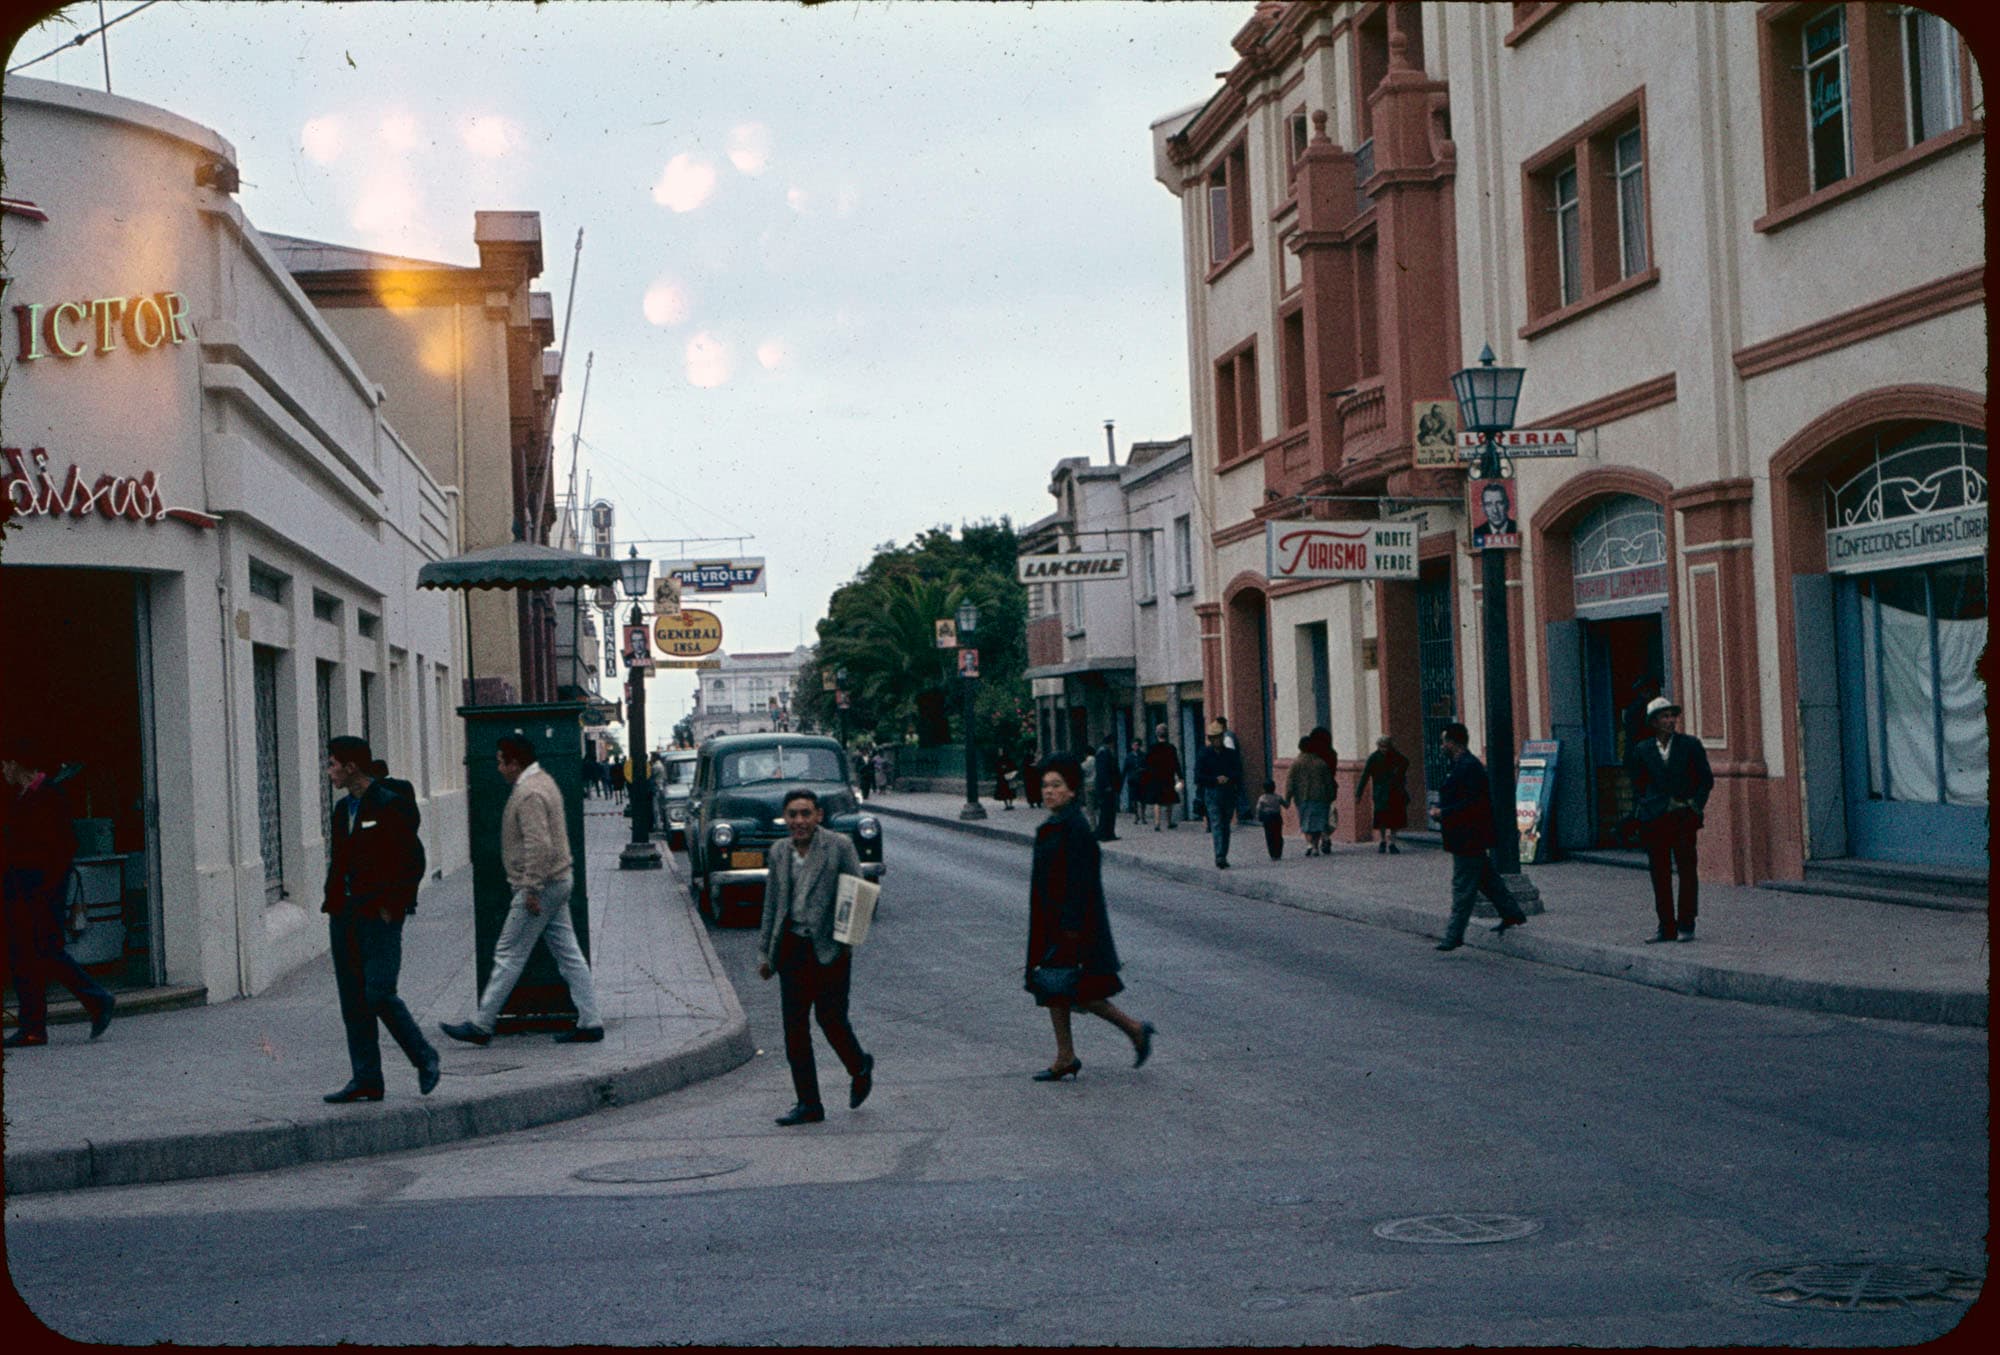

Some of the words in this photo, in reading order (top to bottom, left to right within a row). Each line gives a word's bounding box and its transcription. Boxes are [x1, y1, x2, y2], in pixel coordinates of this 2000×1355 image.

[1375, 531, 1412, 547] NORTE
[1836, 529, 1912, 558] CONFECCIONES
[1912, 521, 1954, 548] CAMISAS
[1279, 526, 1371, 575] TURISMO
[1024, 558, 1124, 577] LAN-CHILE
[1375, 554, 1412, 570] VERDE
[674, 569, 754, 584] CHEVROLET
[657, 628, 718, 640] GENERAL
[673, 642, 702, 652] INSA
